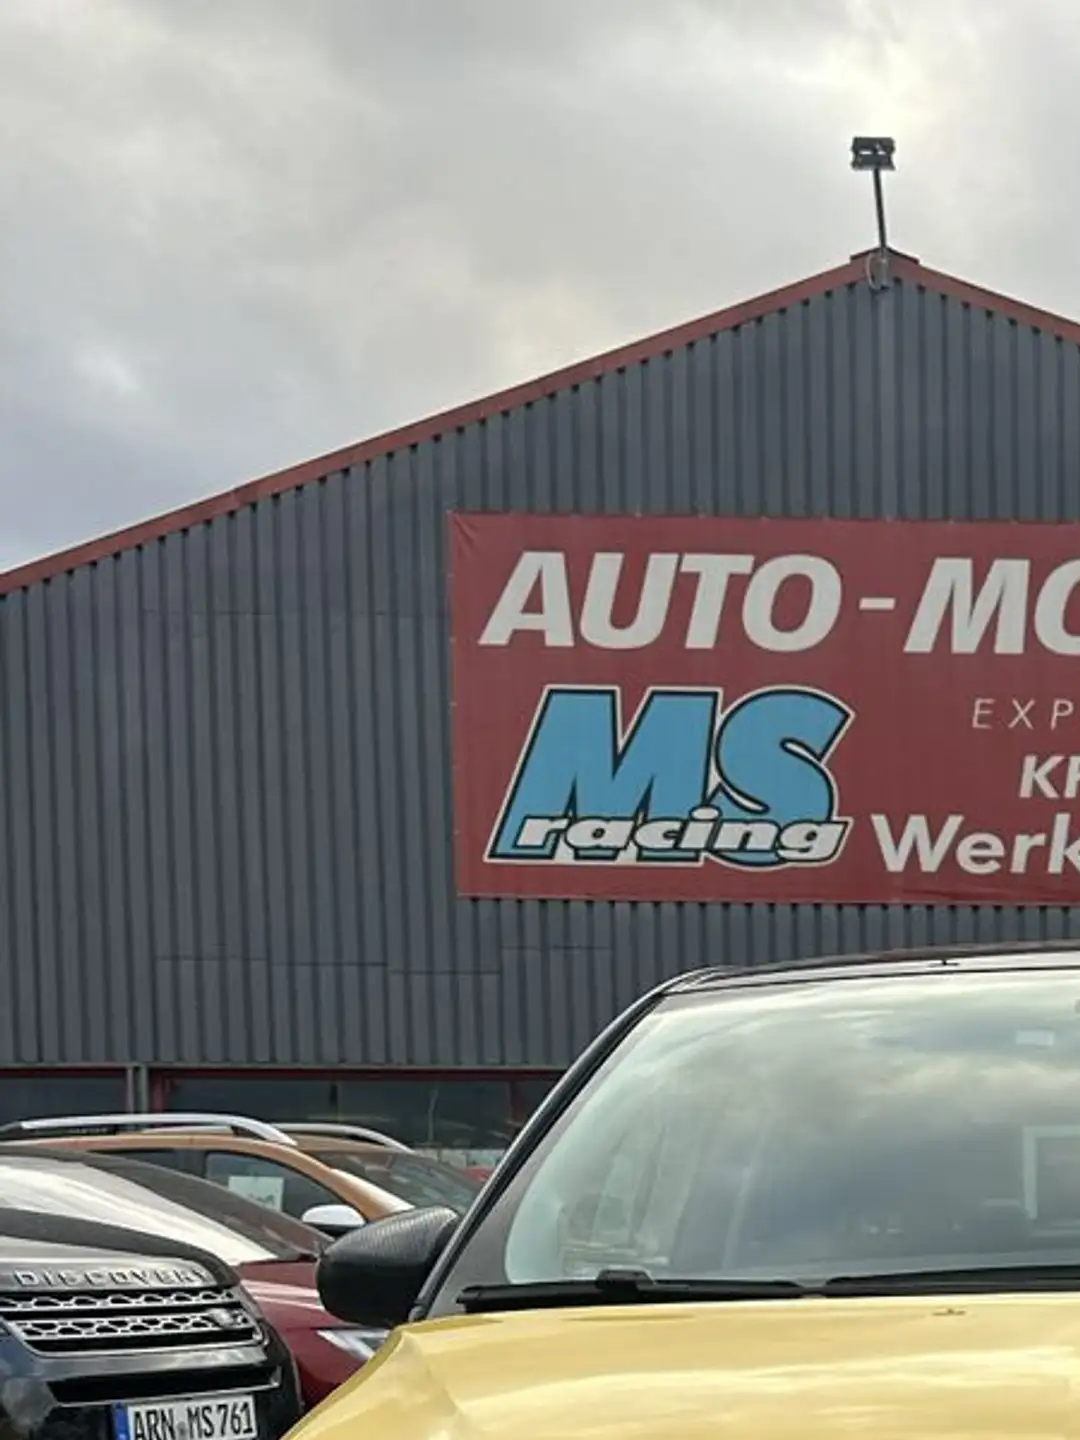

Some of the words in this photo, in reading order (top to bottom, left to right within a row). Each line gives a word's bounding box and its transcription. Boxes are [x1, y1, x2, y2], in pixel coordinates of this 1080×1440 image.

[478, 551, 843, 653] AUTO
[484, 684, 856, 872] MS
[513, 804, 852, 864] racing
